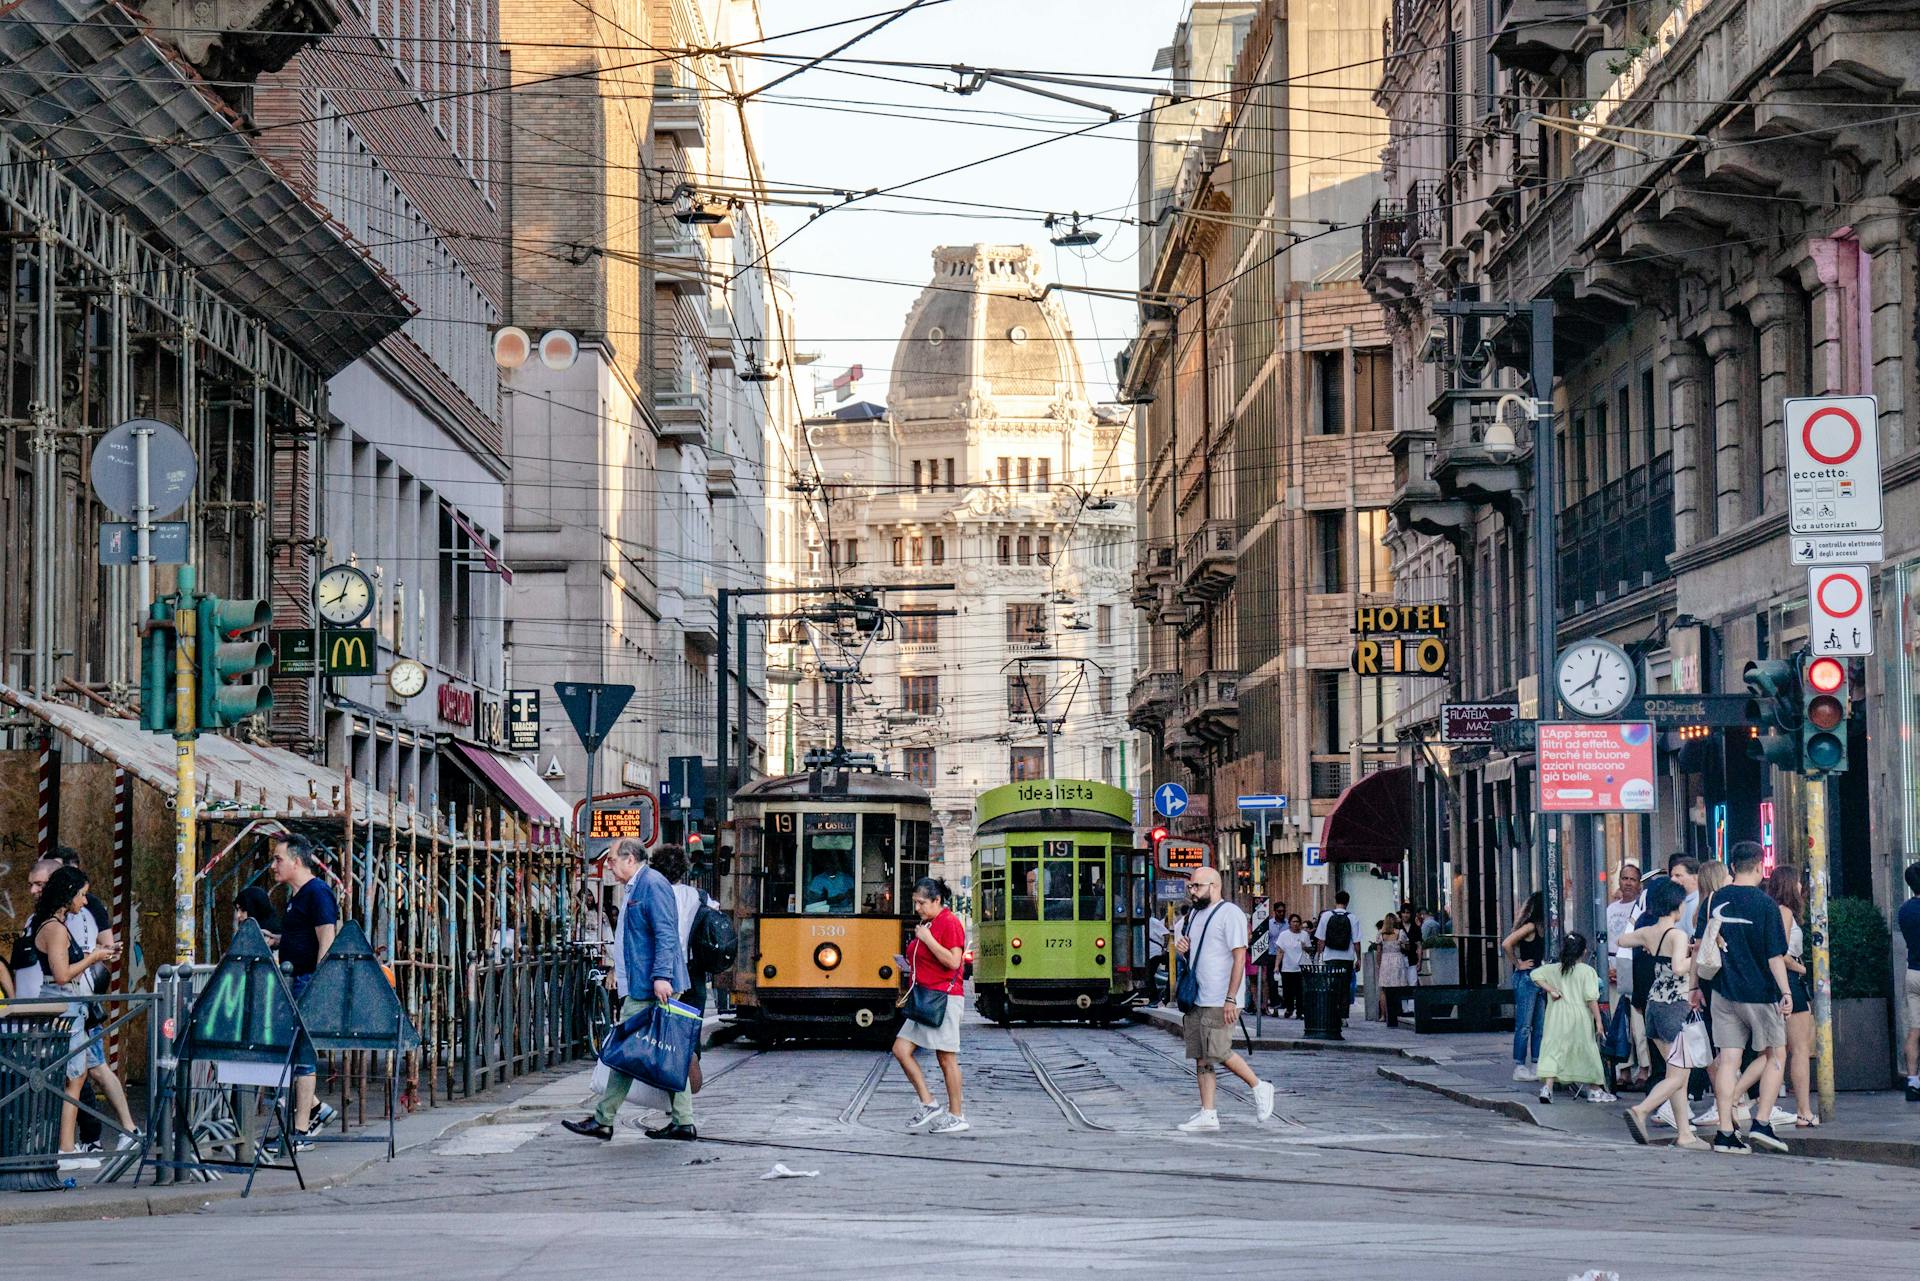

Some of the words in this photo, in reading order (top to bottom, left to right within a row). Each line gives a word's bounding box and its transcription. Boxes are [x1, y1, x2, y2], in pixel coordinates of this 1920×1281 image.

[1793, 469, 1849, 479] eccetto:
[1810, 521, 1857, 530] autorizzati
[1818, 541, 1846, 549] controllo
[1819, 549, 1834, 557] degli
[1357, 604, 1446, 631] HOTEL
[1357, 637, 1446, 673] RIO
[513, 691, 536, 721] T
[1450, 710, 1489, 720] FILATELIA
[511, 721, 538, 731] TABACCHI
[1541, 729, 1572, 740] L'App
[1574, 730, 1607, 738] senza
[1542, 739, 1563, 748] filtri
[1565, 739, 1580, 748] ad
[1582, 739, 1621, 748] effetto.
[1542, 749, 1580, 759] Perché
[1583, 749, 1592, 759] le
[1595, 749, 1630, 759] buone
[1542, 760, 1574, 770] azioni
[1577, 761, 1625, 770] nascono
[1542, 771, 1560, 783] già
[1562, 771, 1593, 781] belle.
[1018, 784, 1093, 801] idealista
[775, 813, 792, 833] 19
[1049, 841, 1068, 857] 19
[811, 924, 846, 937] 1530
[1045, 939, 1072, 948] 1773
